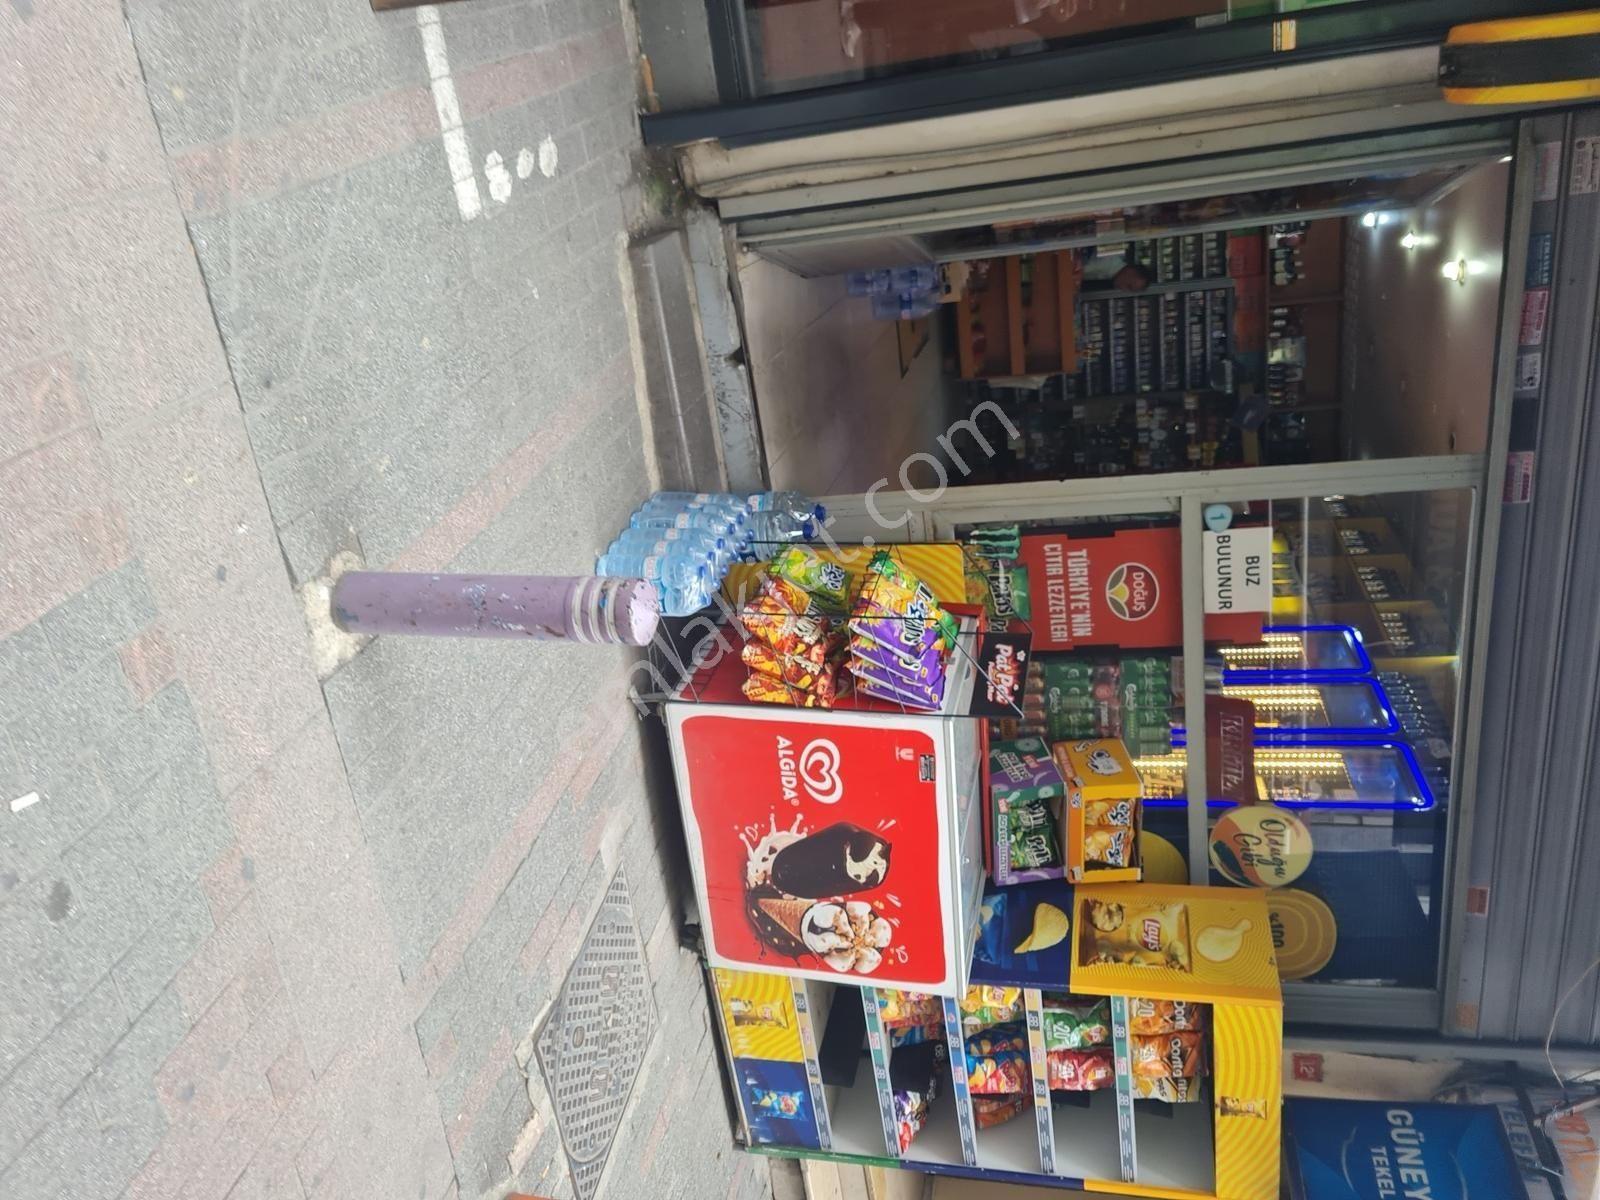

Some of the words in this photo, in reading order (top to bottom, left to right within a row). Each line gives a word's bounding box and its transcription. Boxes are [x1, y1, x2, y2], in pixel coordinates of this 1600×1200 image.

[1042, 543, 1064, 576] ÇITIR
[1216, 534, 1233, 610] BULUNUR
[1245, 555, 1260, 587] BUZ
[1046, 579, 1072, 643] LEZZETLERİ
[1066, 548, 1095, 637] TÜRKİYE'NİN
[1131, 571, 1149, 612] DOĞUŞ
[994, 643, 1014, 671] Pat
[1233, 833, 1263, 867] Gibi
[1257, 819, 1288, 878] Olduğu
[1142, 919, 1163, 952] Lay's
[1370, 1146, 1396, 1199] TEKEL
[1386, 1109, 1434, 1200] GÜNEY
